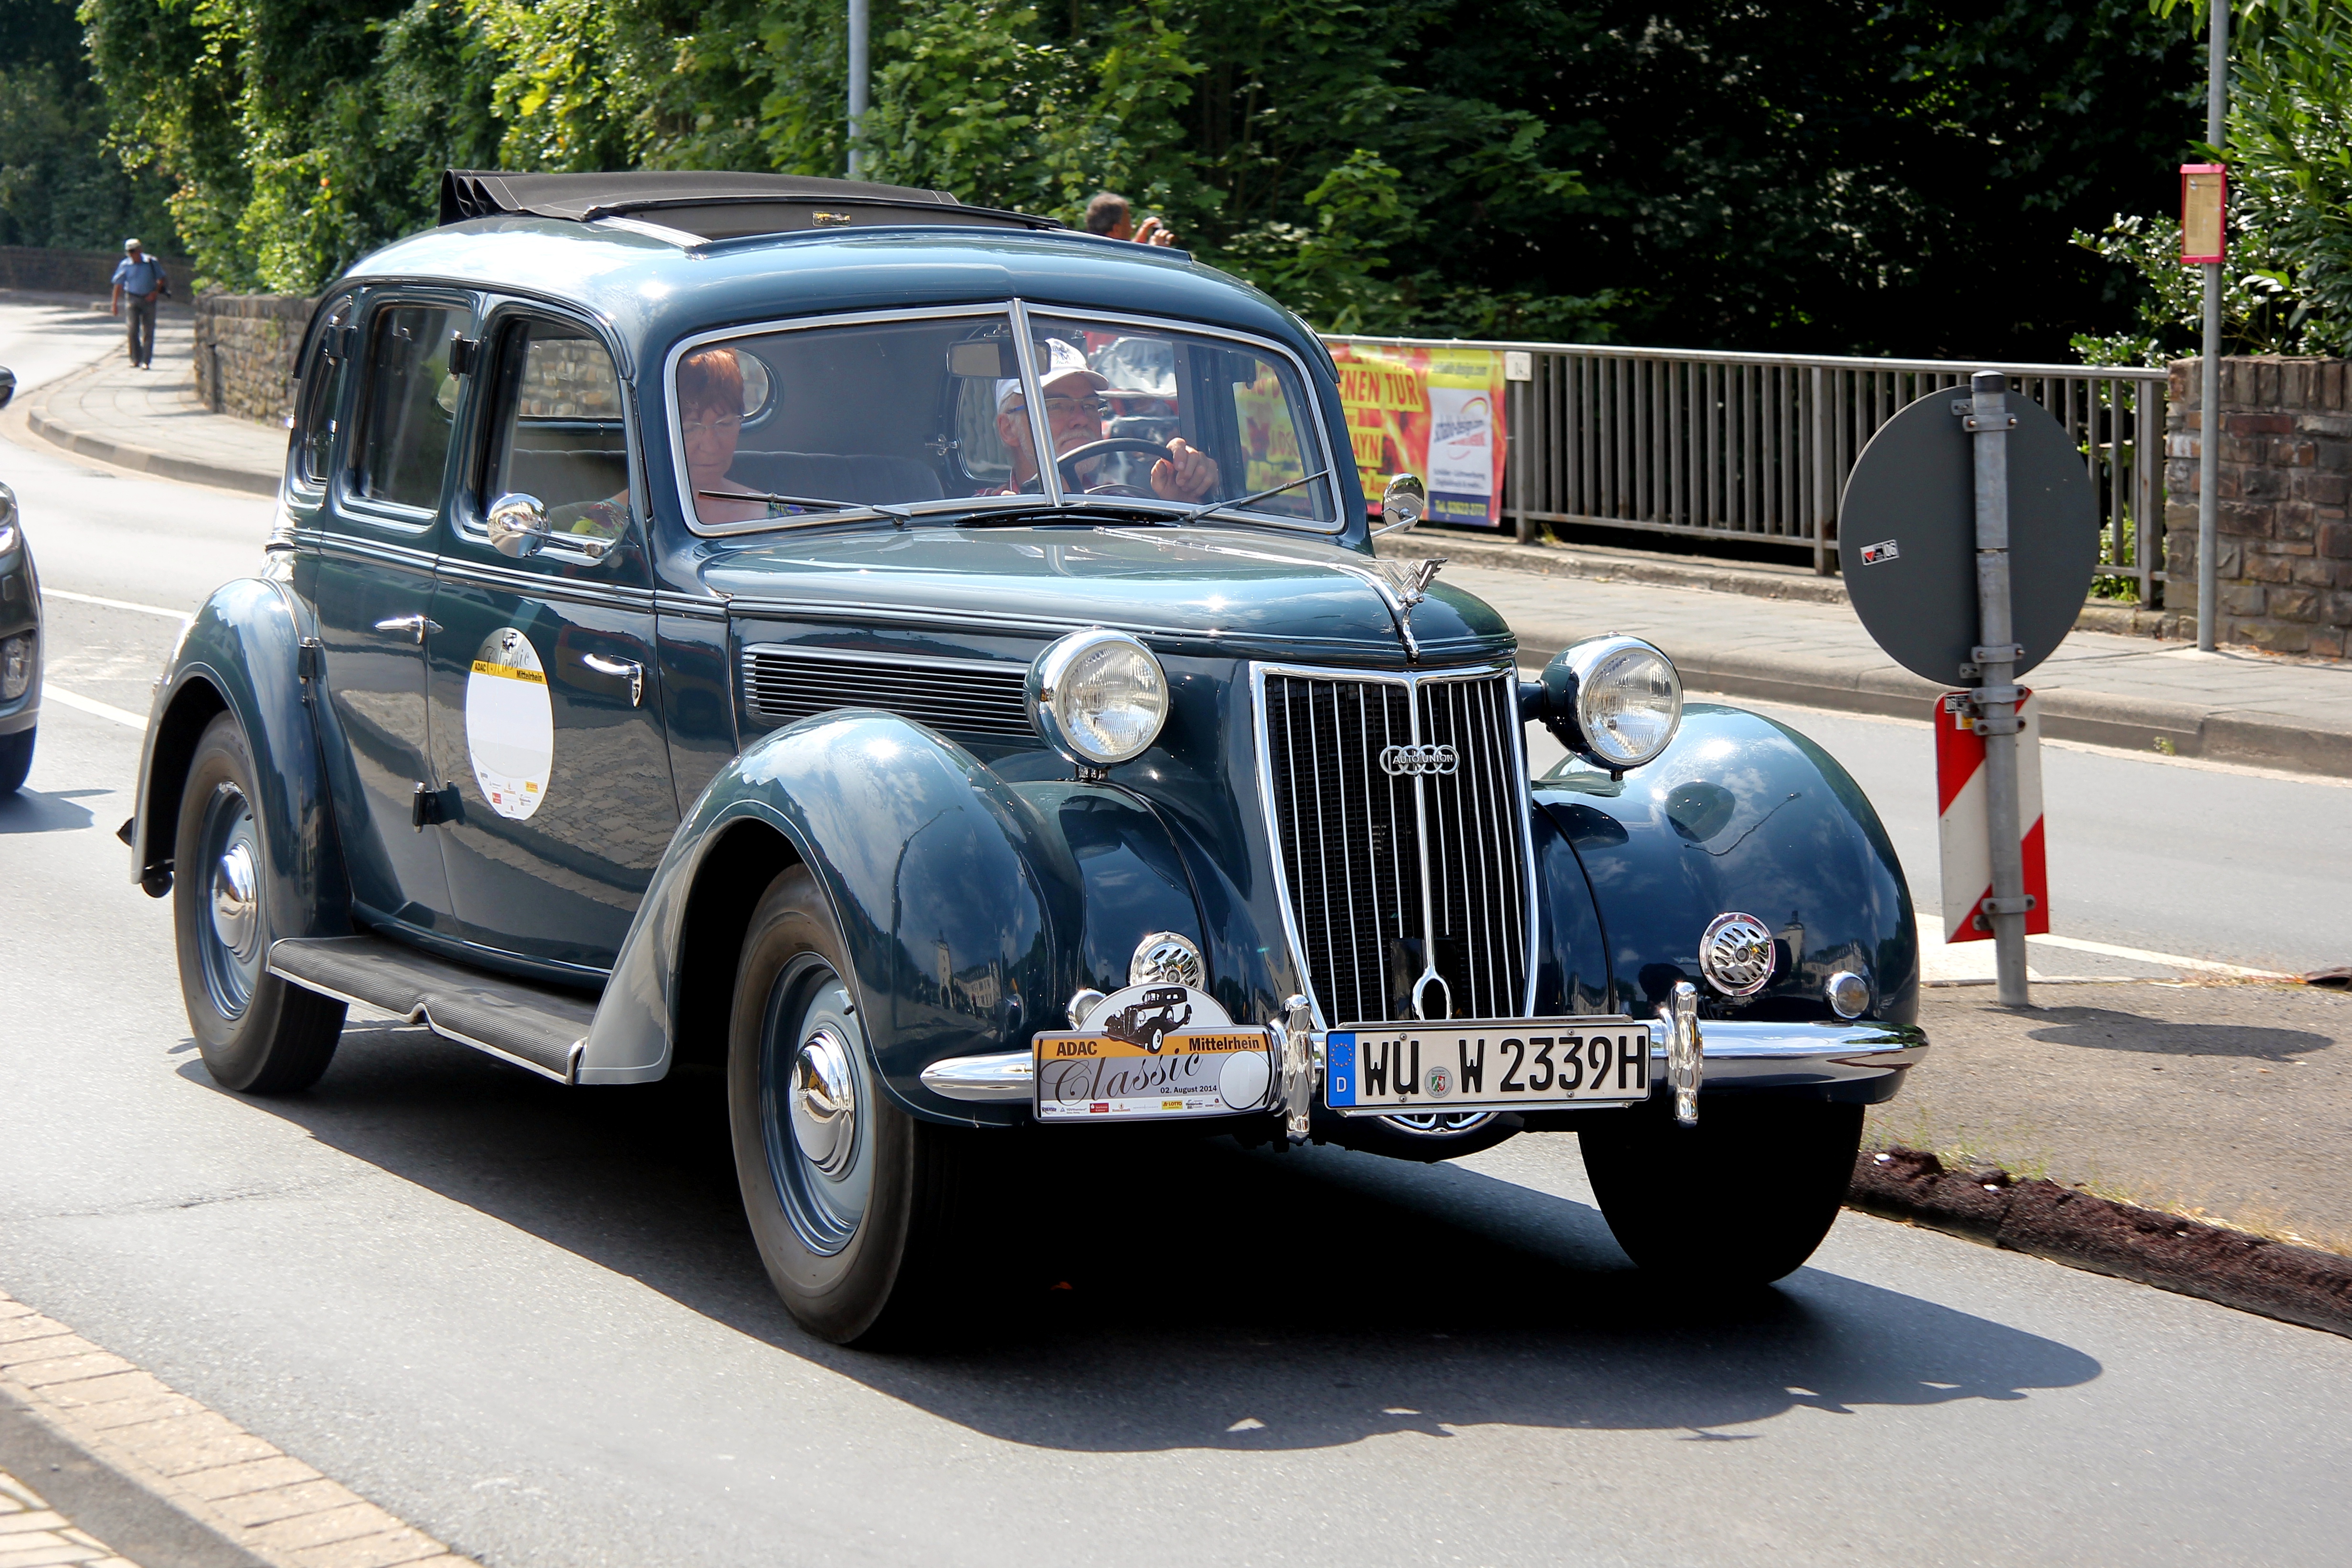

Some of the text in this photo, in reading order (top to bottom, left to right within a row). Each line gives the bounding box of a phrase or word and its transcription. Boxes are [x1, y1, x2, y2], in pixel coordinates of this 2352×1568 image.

[1386, 366, 1419, 405] TÜR
[483, 646, 530, 677] Classic
[474, 662, 542, 682] ADAC Mittelrhein
[1393, 754, 1453, 764] AUTO UNION
[1057, 1037, 1260, 1056] ADAC Mittelrhein
[1458, 1038, 1485, 1093] W
[1500, 1035, 1646, 1092] 2339H
[1041, 1047, 1204, 1106] Classic
[1336, 1077, 1346, 1092] D
[1173, 1086, 1198, 1094] August
[1199, 1084, 1217, 1092] 2014
